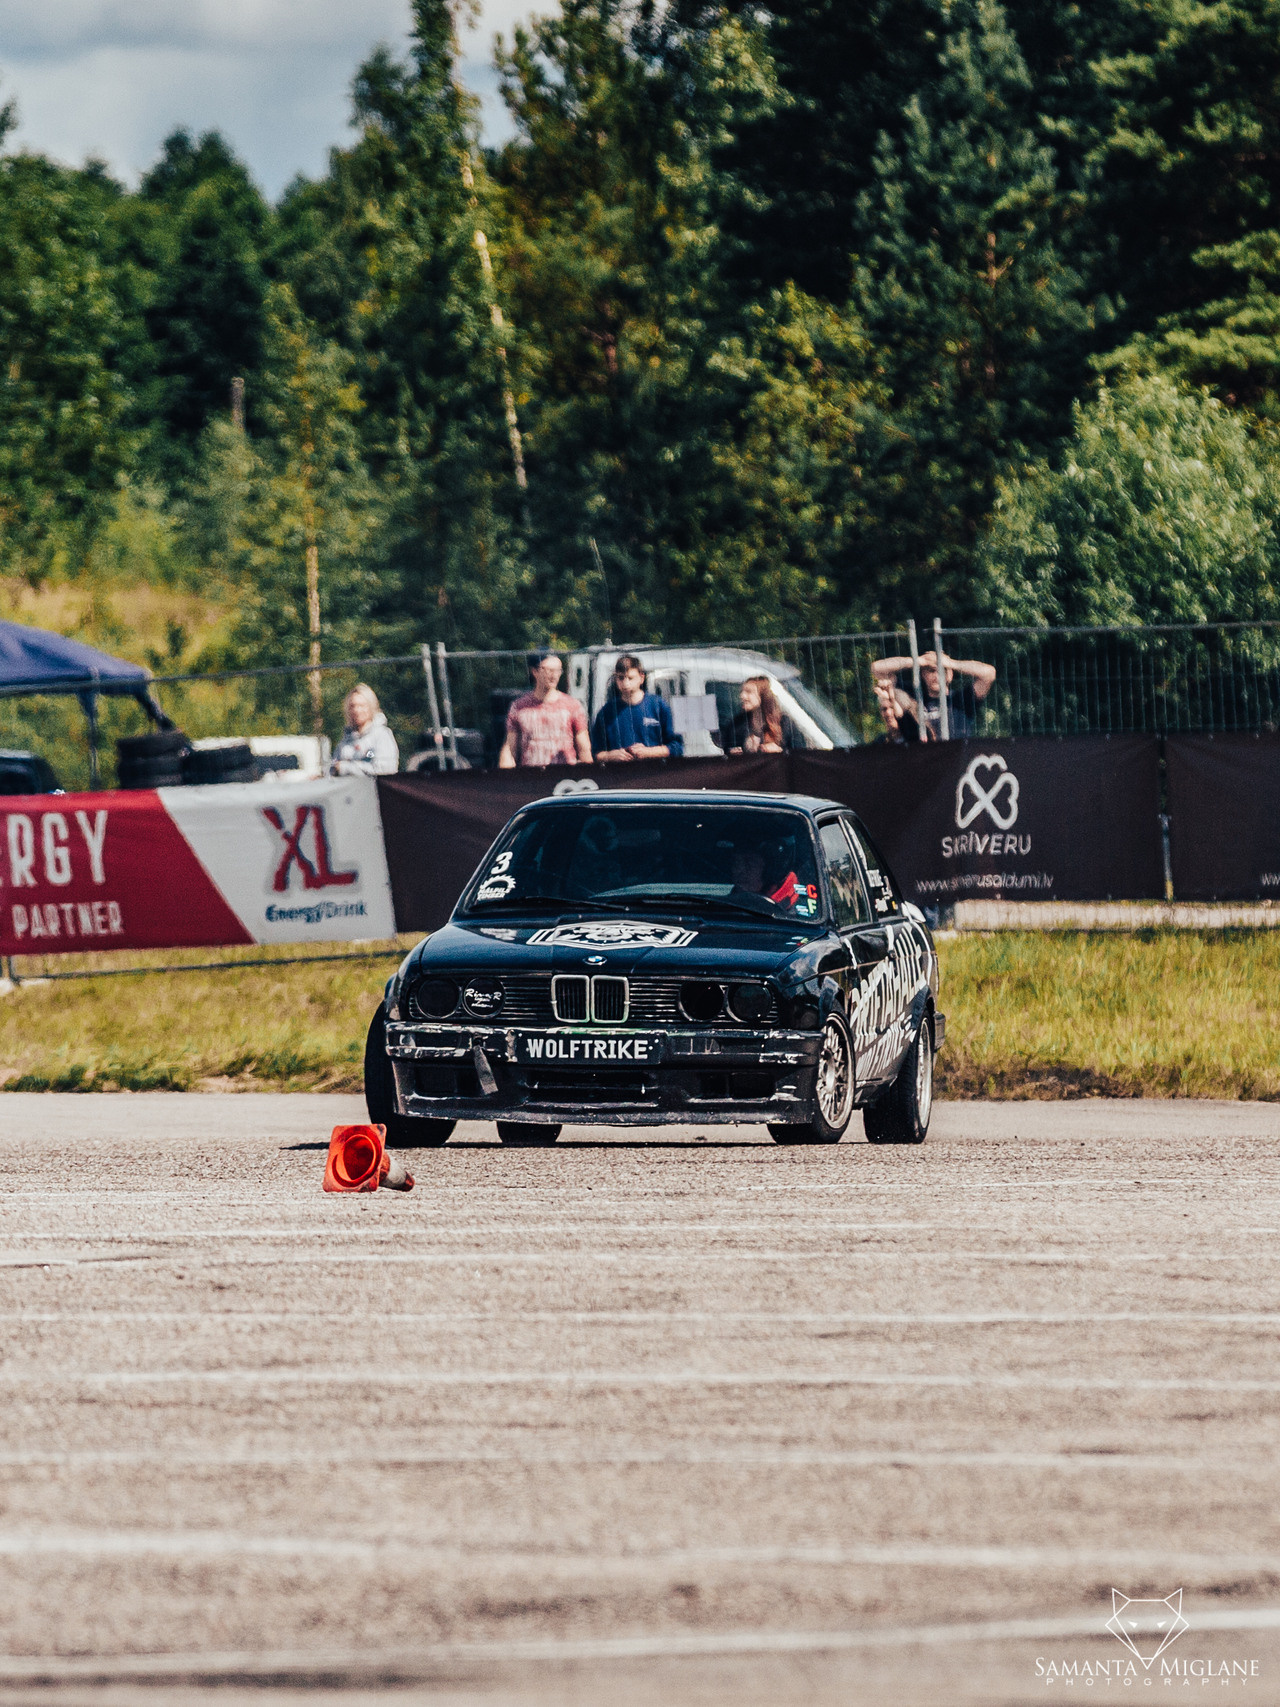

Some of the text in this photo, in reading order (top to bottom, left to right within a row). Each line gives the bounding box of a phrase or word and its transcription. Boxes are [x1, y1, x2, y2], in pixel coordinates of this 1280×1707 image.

[261, 805, 359, 892] XL
[491, 851, 514, 875] 3
[12, 901, 124, 941] PARTNER
[527, 1039, 648, 1059] WOLFTRIKE
